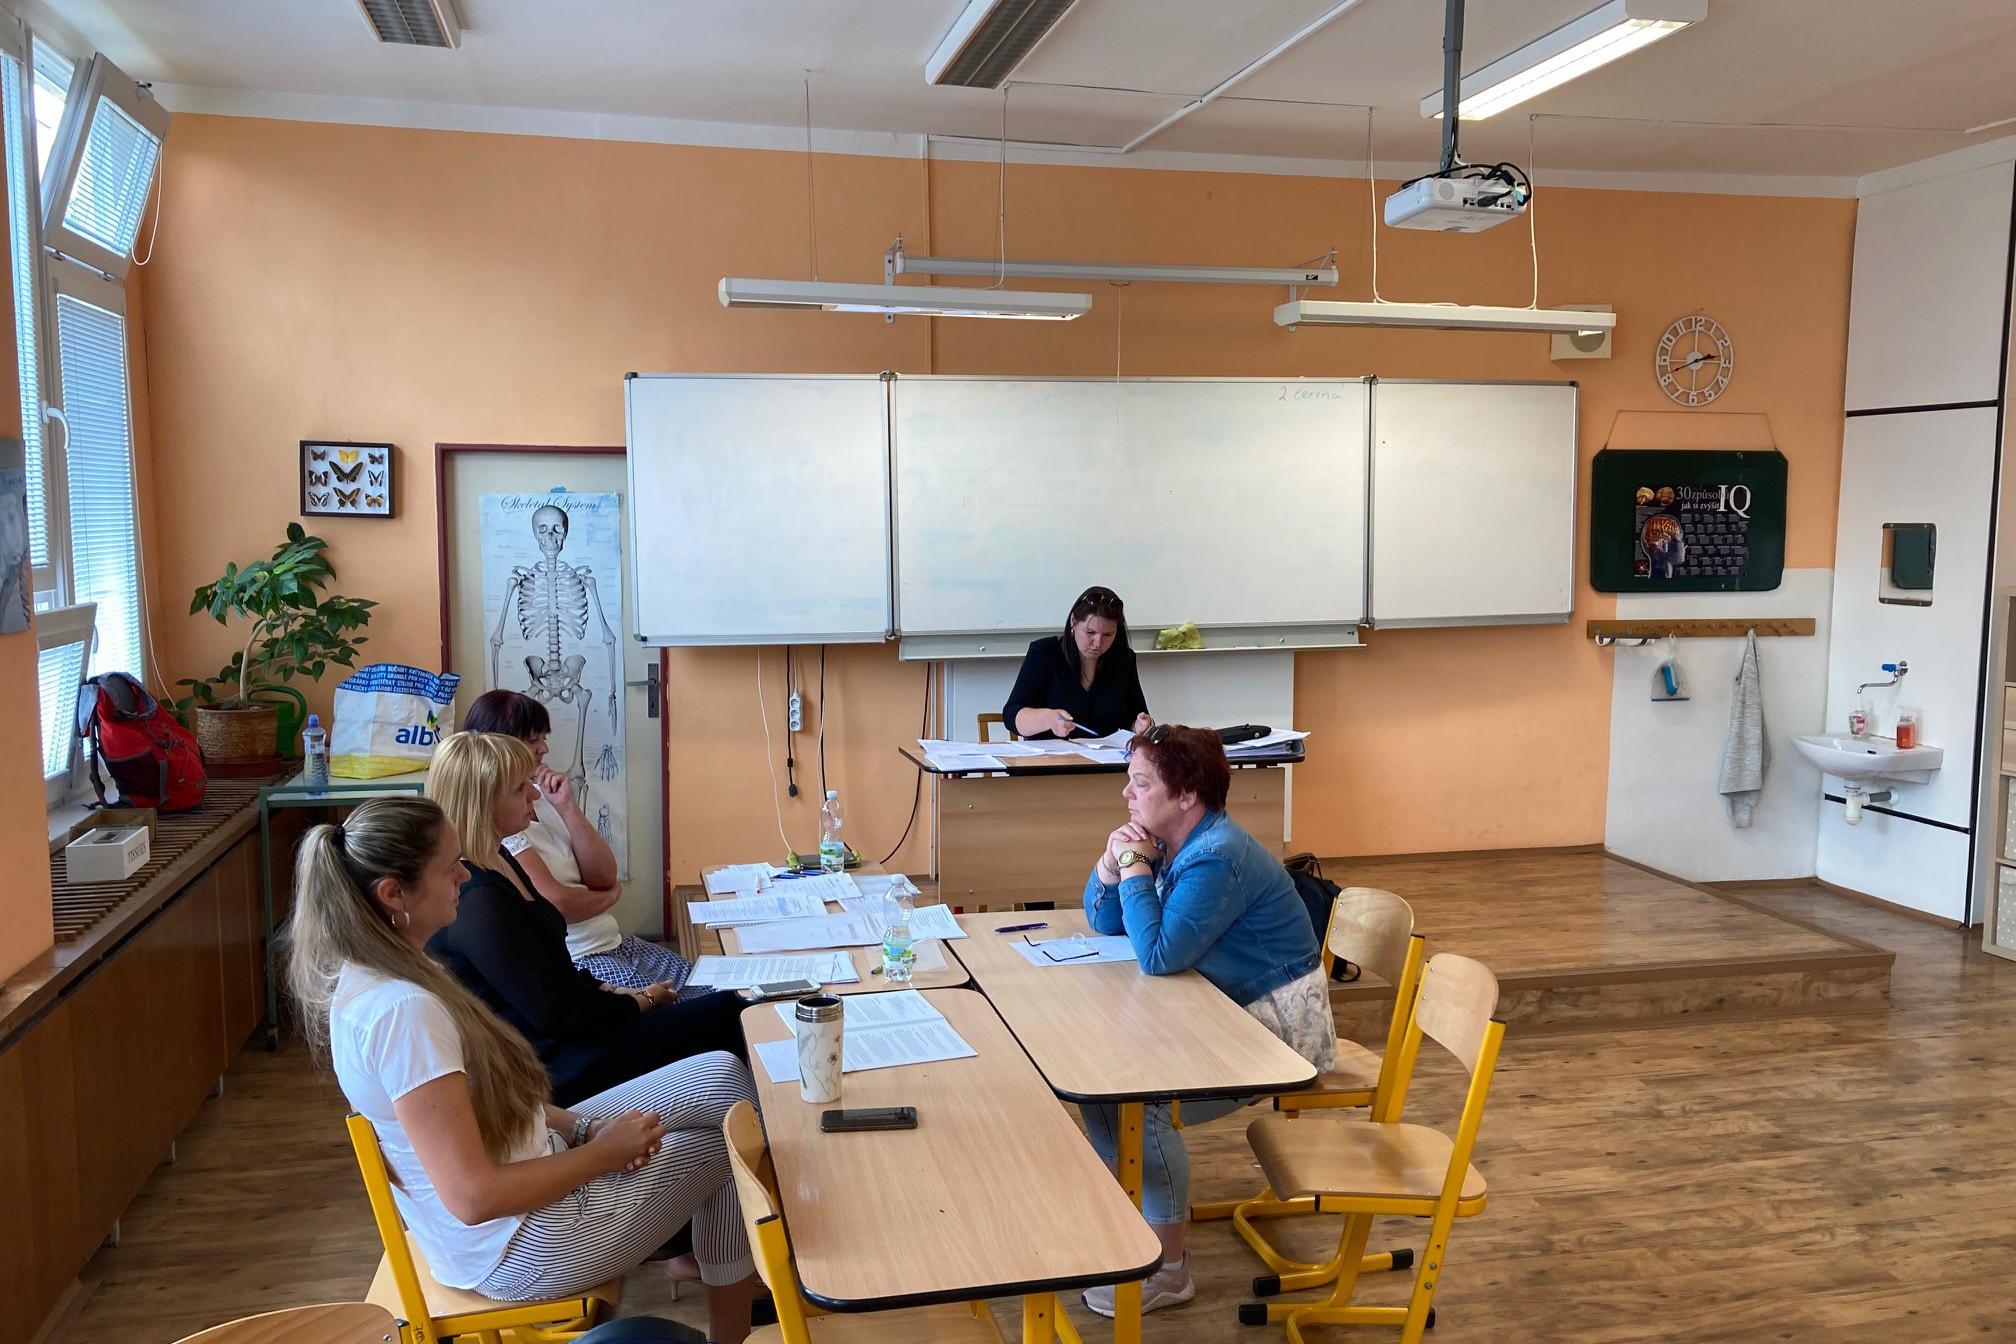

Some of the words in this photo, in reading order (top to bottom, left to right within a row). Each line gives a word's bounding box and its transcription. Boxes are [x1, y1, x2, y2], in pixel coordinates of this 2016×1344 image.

[1691, 316, 1705, 331] 12
[1661, 333, 1675, 350] 10
[1718, 335, 1730, 350] 2
[1720, 357, 1732, 369] 3
[1660, 373, 1673, 386] 8
[1718, 376, 1728, 389] 4
[1671, 385, 1684, 399] 7
[1689, 391, 1698, 406] 6
[1704, 387, 1715, 401] 5
[1676, 486, 1692, 500] 30
[501, 495, 550, 513] Skeletal
[552, 496, 602, 513] System
[1681, 501, 1692, 511] jak
[1716, 484, 1752, 519] IQ
